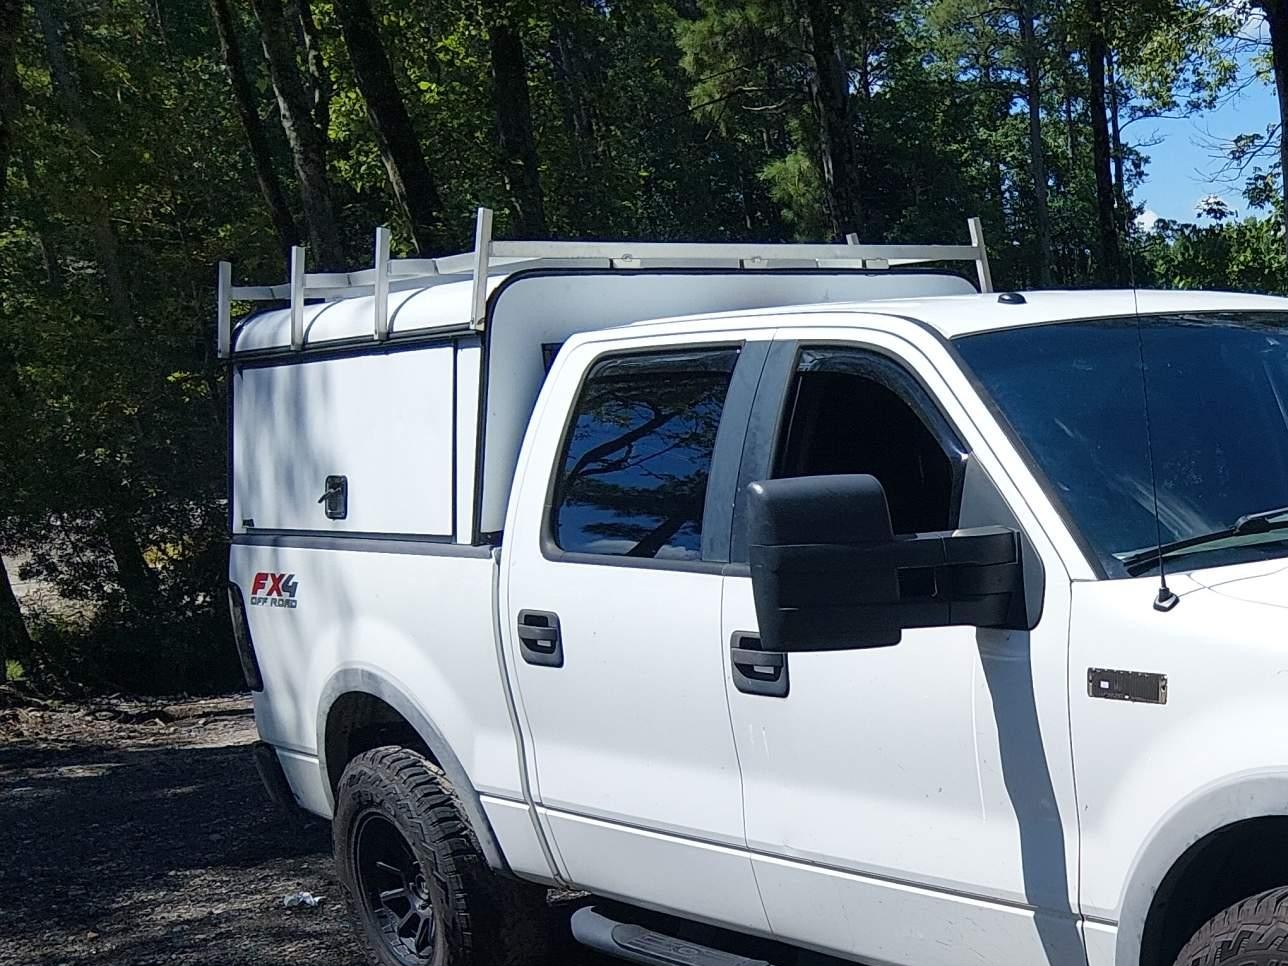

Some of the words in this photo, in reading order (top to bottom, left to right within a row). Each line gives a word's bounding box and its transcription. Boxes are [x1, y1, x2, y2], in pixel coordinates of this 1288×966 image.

[251, 572, 299, 597] FX4
[250, 596, 268, 606] OFF
[270, 598, 298, 608] ROAD
